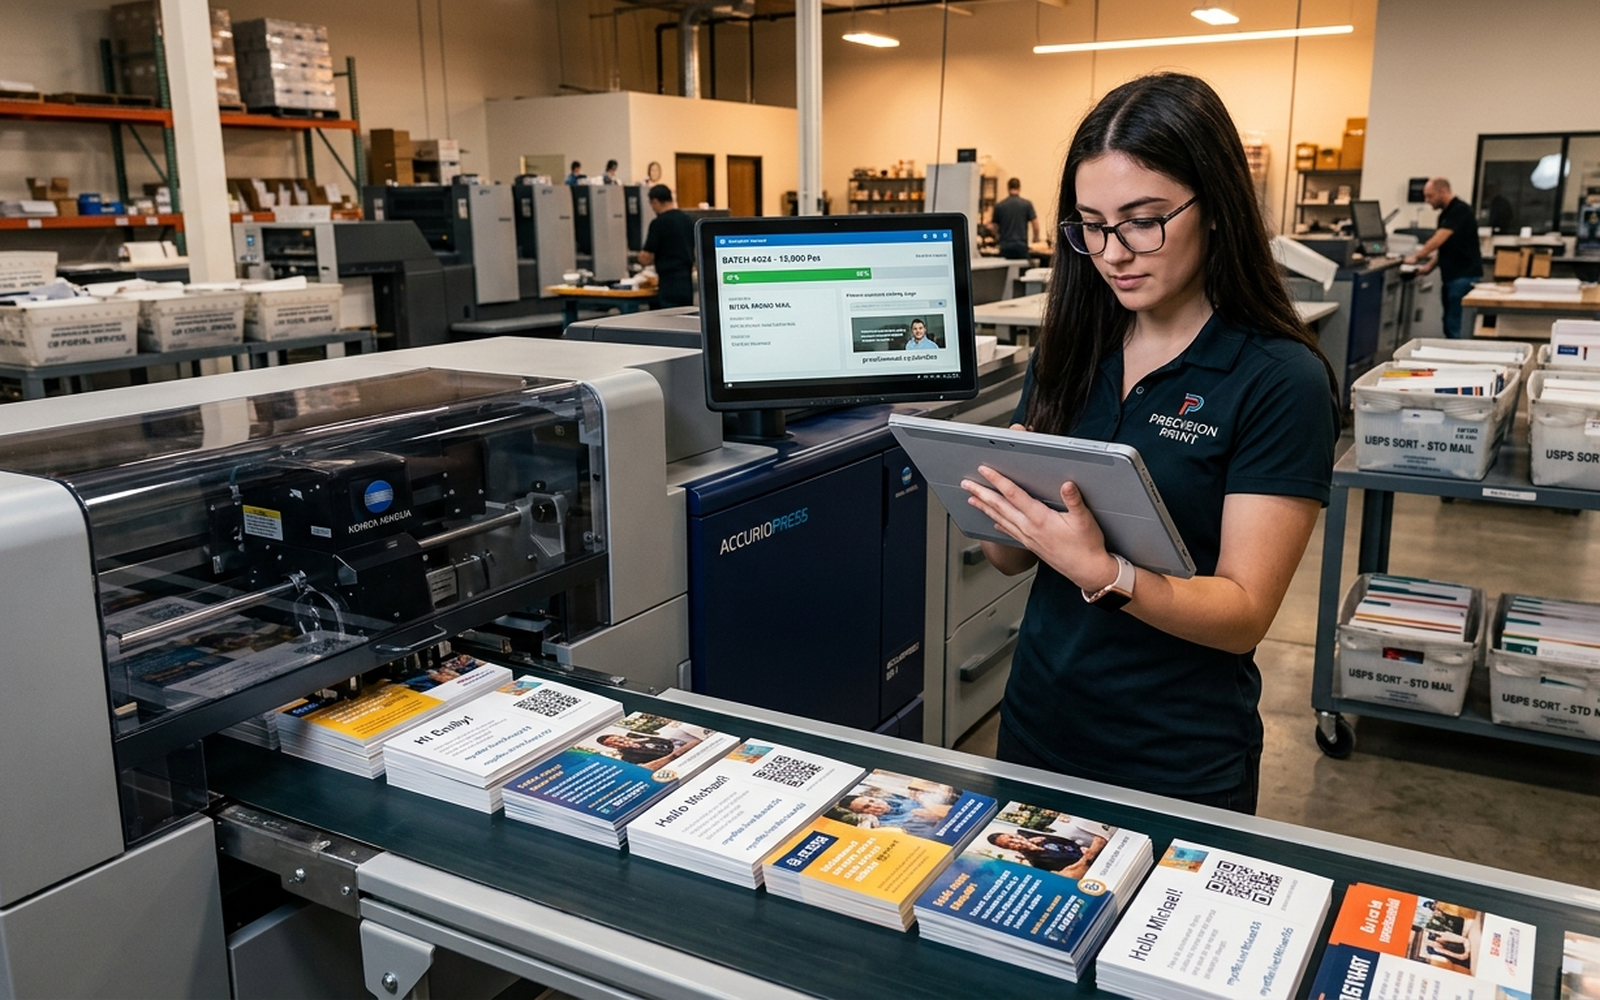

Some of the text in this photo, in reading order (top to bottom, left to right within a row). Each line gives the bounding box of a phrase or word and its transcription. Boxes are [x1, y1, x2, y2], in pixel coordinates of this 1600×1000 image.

[1392, 438, 1419, 449] SORT
[1449, 443, 1474, 454] MAIL
[1546, 449, 1600, 464] USPS SOR
[1349, 668, 1374, 680] USPS
[1376, 673, 1402, 685] SORT
[1532, 698, 1561, 711] SORT
